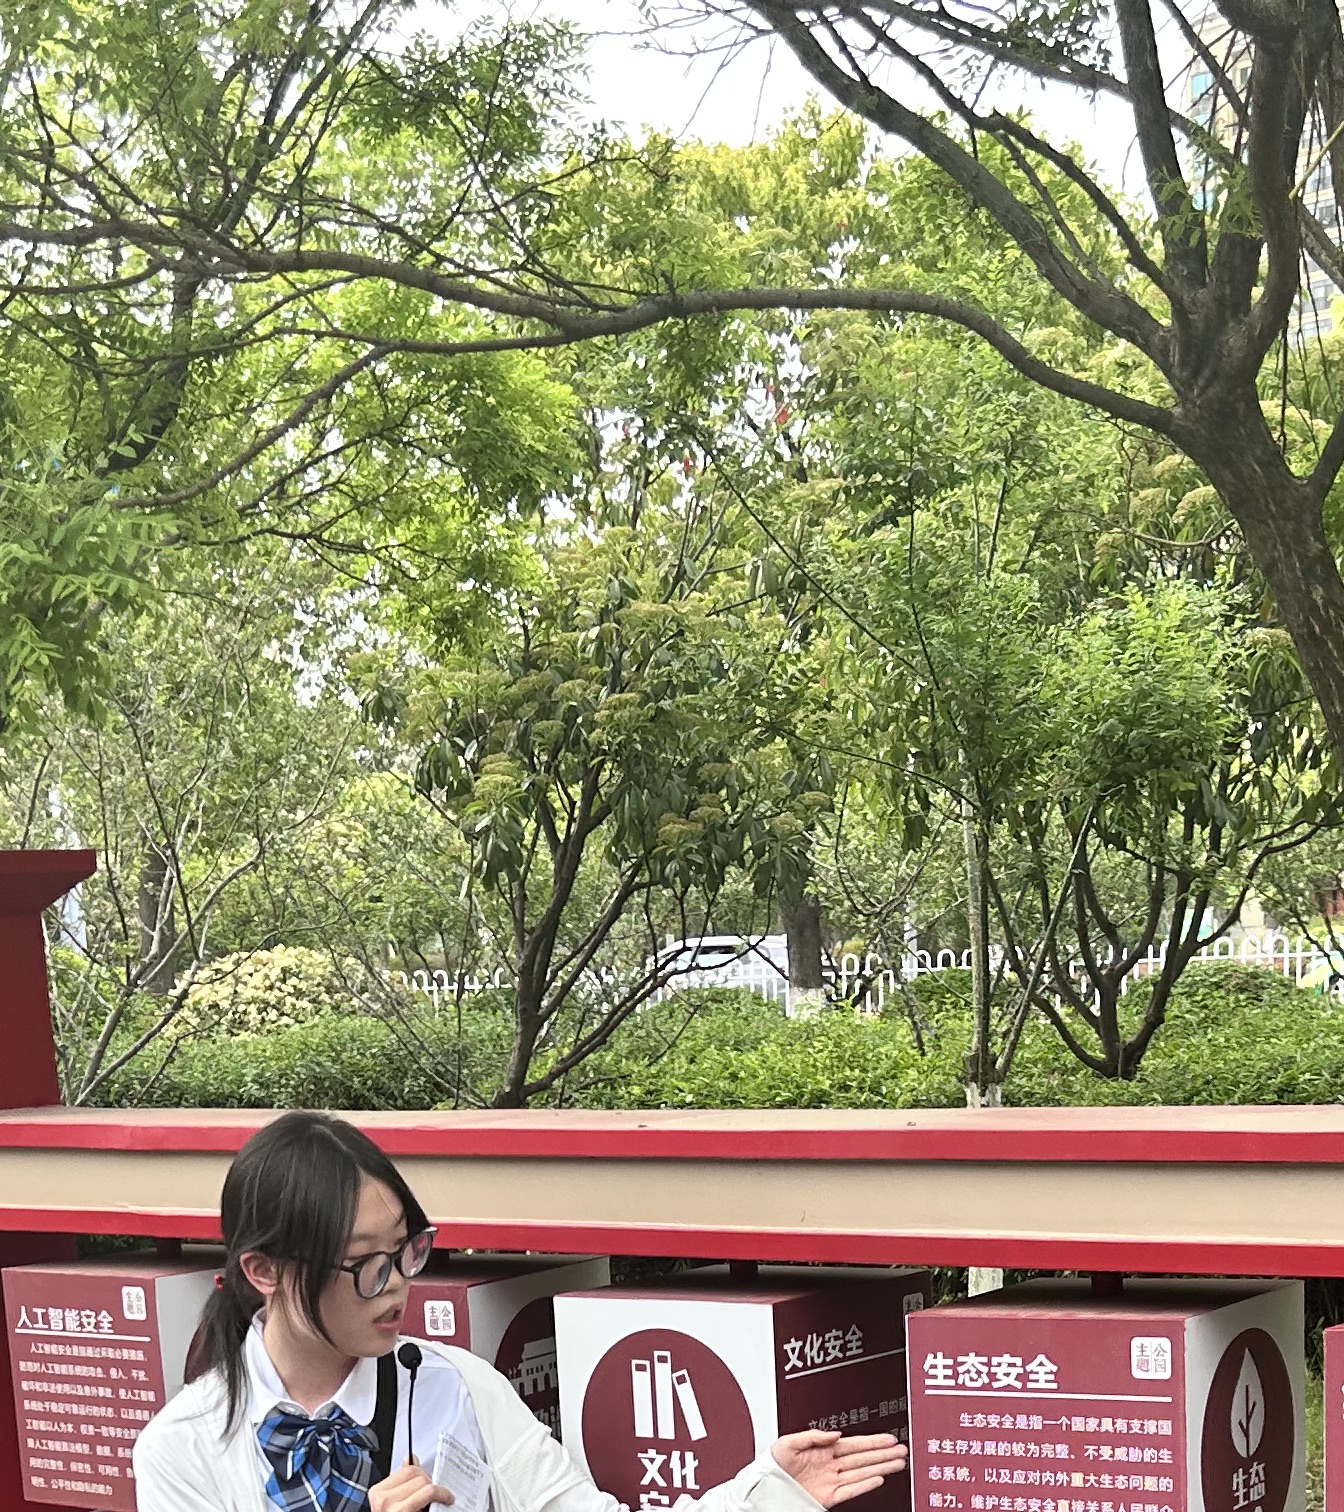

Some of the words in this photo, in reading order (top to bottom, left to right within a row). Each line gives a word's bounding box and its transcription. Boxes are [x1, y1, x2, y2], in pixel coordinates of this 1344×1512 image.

[17, 1305, 114, 1334] 人工智能安全
[783, 1325, 864, 1371] 文化安全
[923, 1352, 1058, 1390] 生态安全
[637, 1448, 700, 1490] 文化
